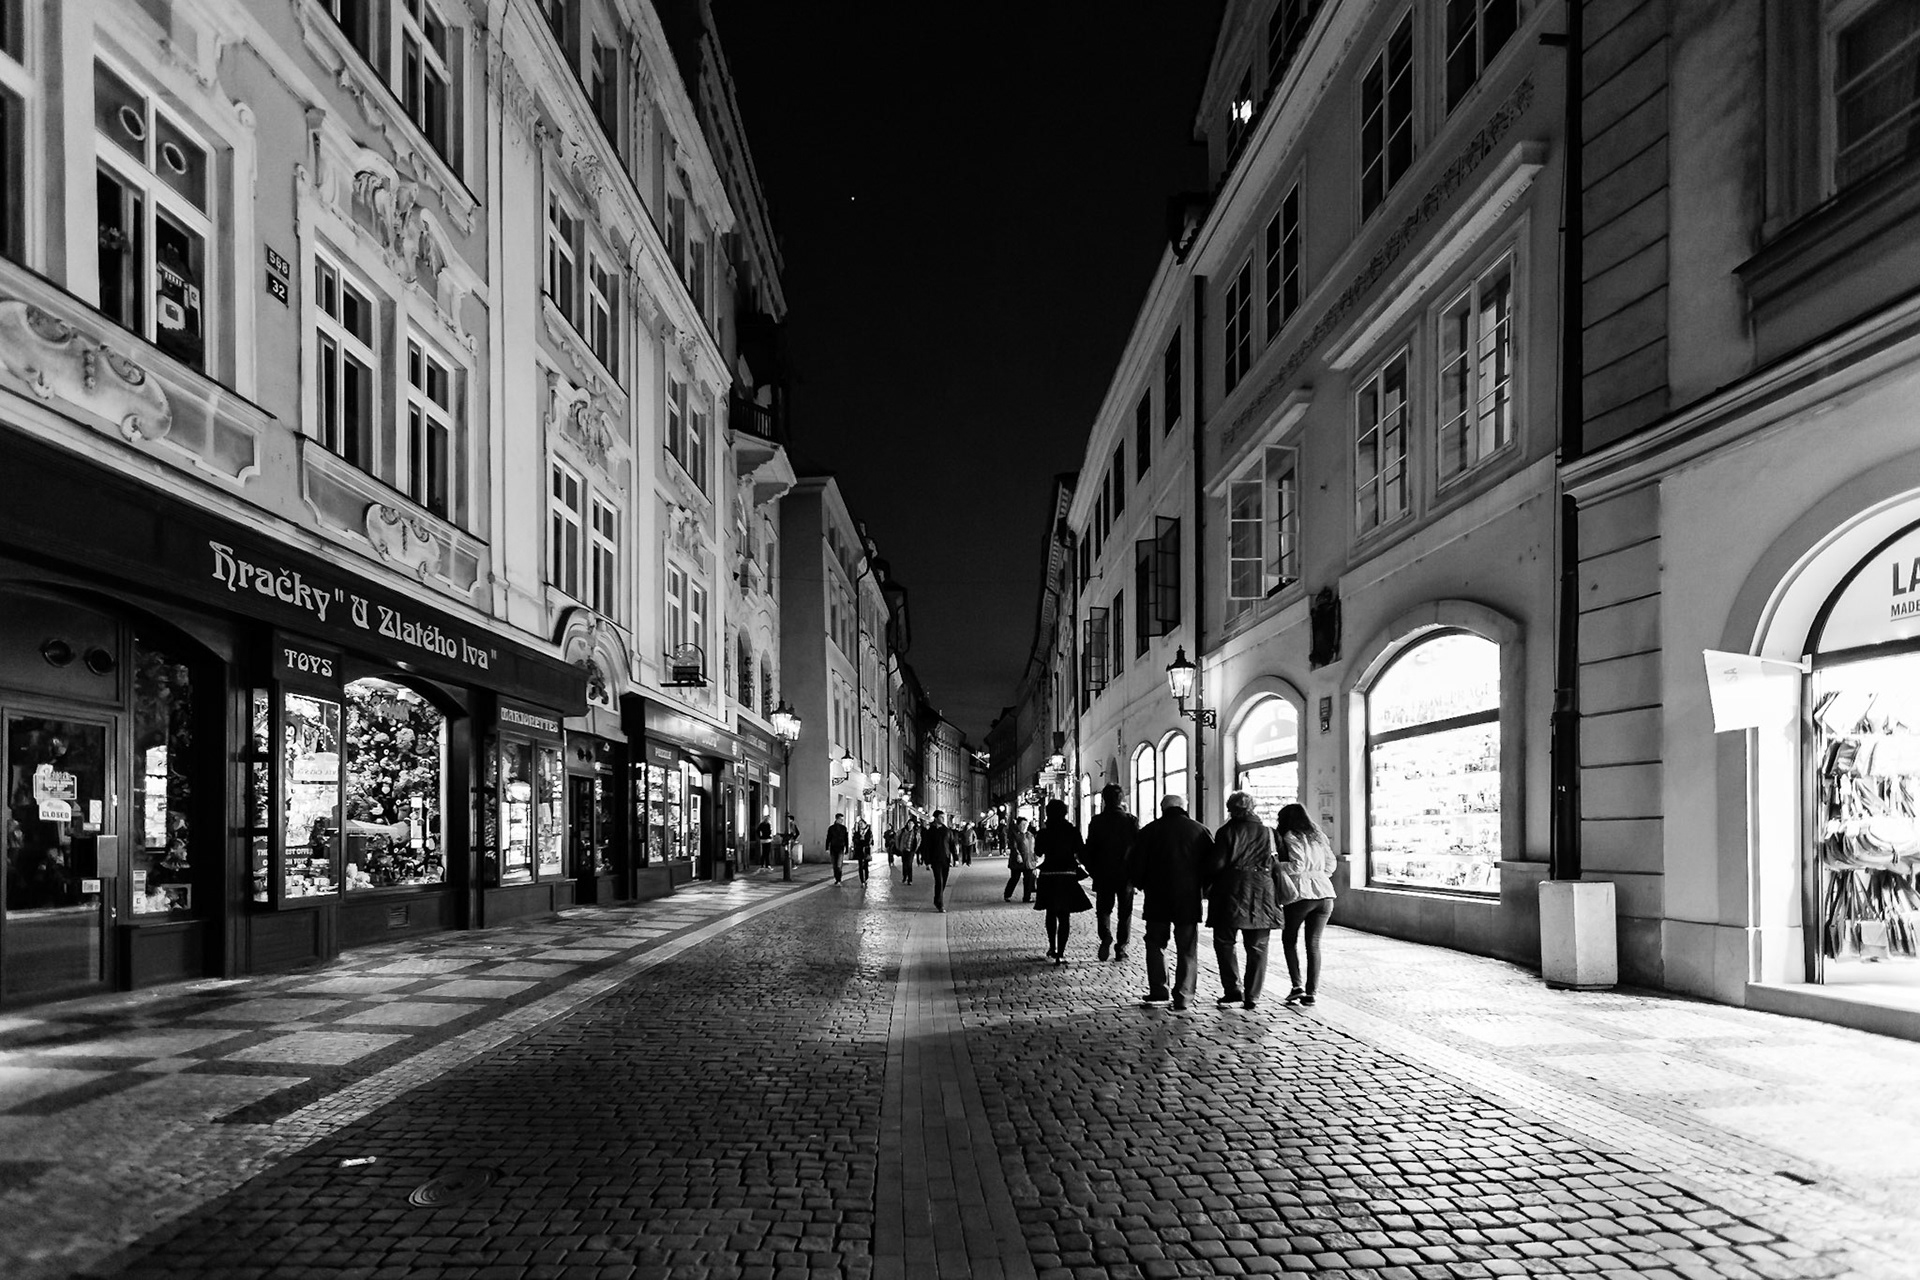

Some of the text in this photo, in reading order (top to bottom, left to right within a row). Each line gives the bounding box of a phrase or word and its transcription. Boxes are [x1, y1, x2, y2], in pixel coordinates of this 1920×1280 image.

[272, 280, 286, 299] 32
[1891, 600, 1920, 617] MADE
[377, 605, 457, 658] Zlatého
[284, 649, 333, 677] TOYS
[41, 811, 69, 819] CLOSED
